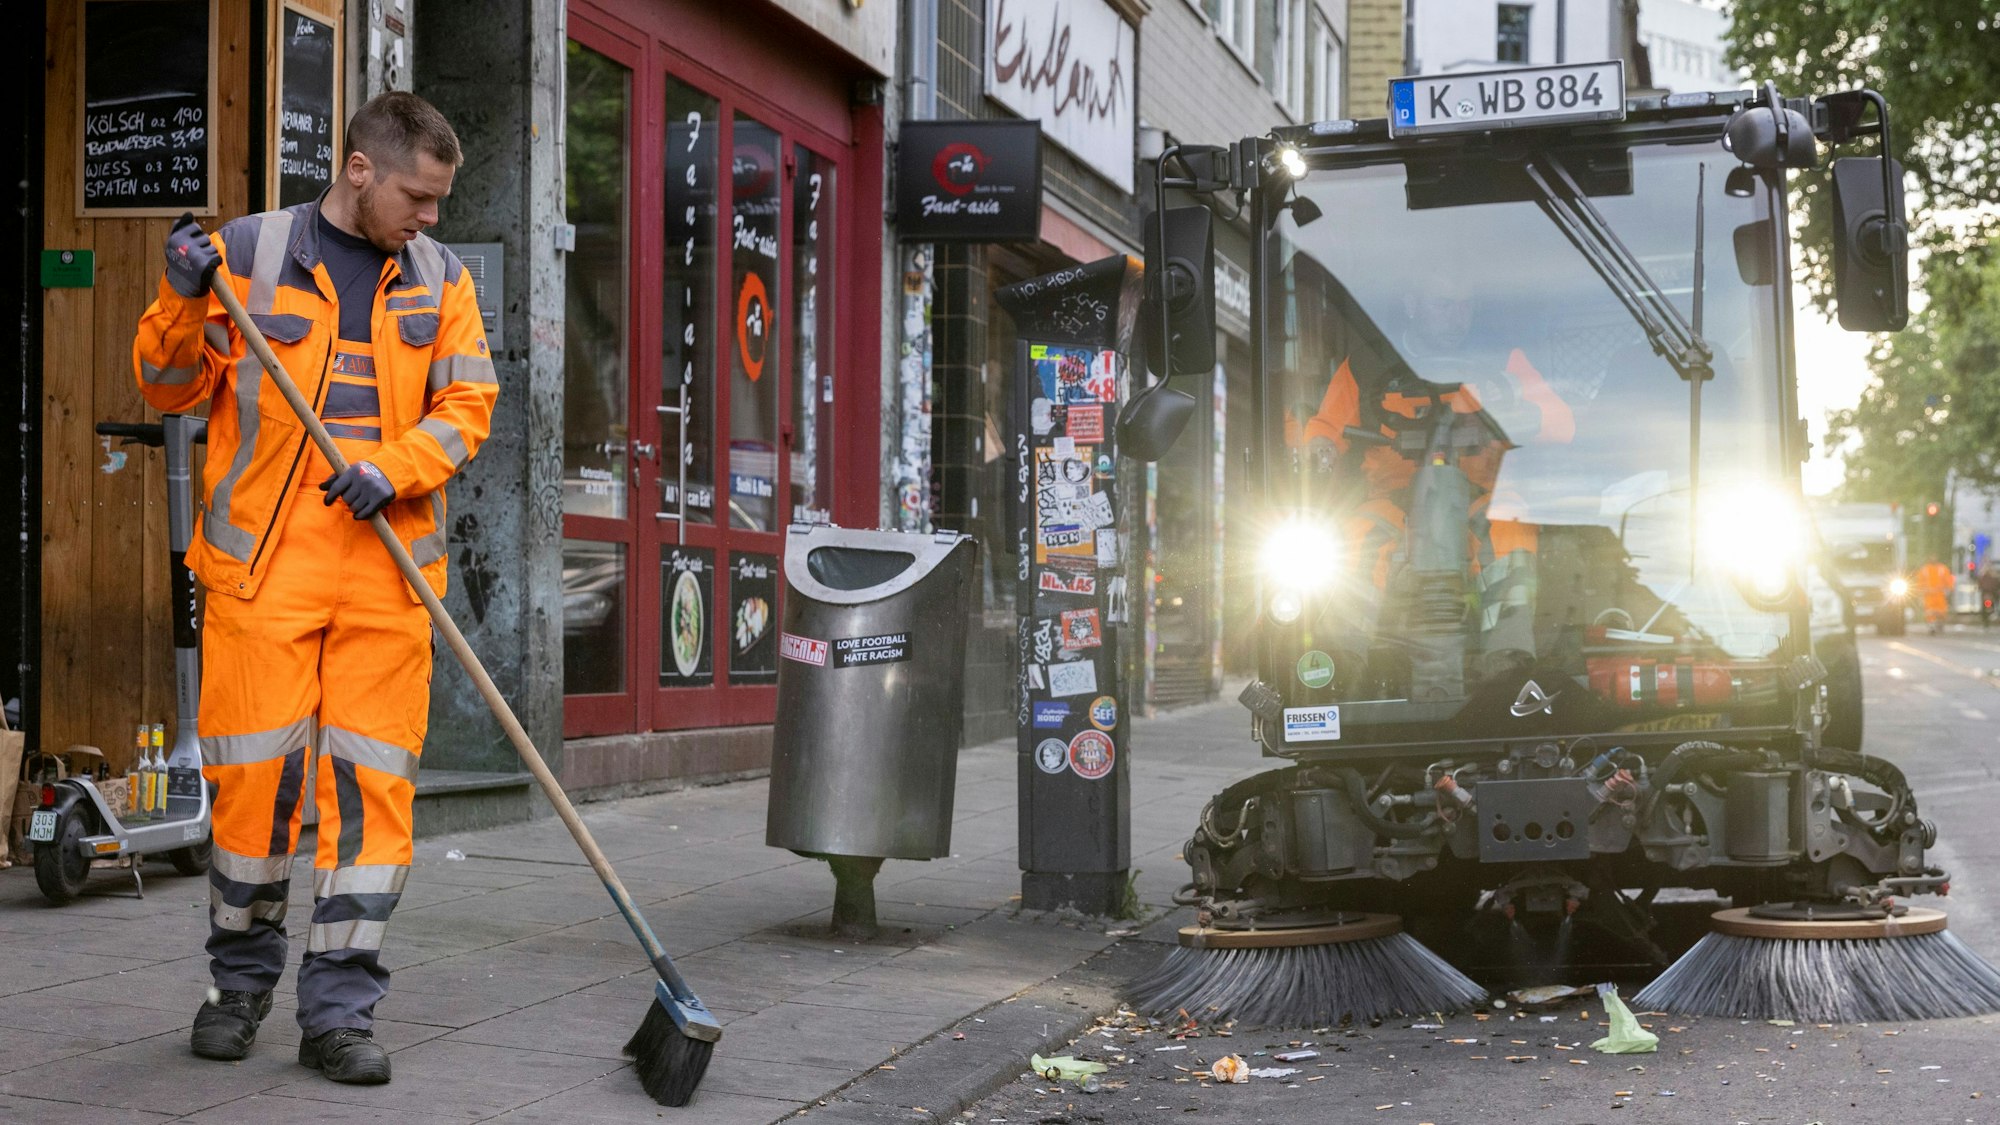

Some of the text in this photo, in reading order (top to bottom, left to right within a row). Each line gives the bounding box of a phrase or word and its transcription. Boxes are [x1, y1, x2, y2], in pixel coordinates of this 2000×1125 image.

[1429, 72, 1603, 119] K WB 884
[86, 111, 145, 136] KÖLSCH
[172, 106, 202, 127] 1,90
[1401, 108, 1410, 120] D
[170, 126, 204, 149] 3,10
[85, 160, 131, 178] WIESS
[172, 156, 198, 173] 2,70
[85, 176, 200, 198] SPATEN 0.5 4,90
[920, 195, 1000, 218] Fant-asia
[837, 634, 907, 650] LOVE FOOTBALL
[843, 648, 903, 663] HATE RACISM
[1286, 712, 1326, 723] FRISSEN
[35, 814, 54, 826] 303
[33, 827, 52, 839] MJM
